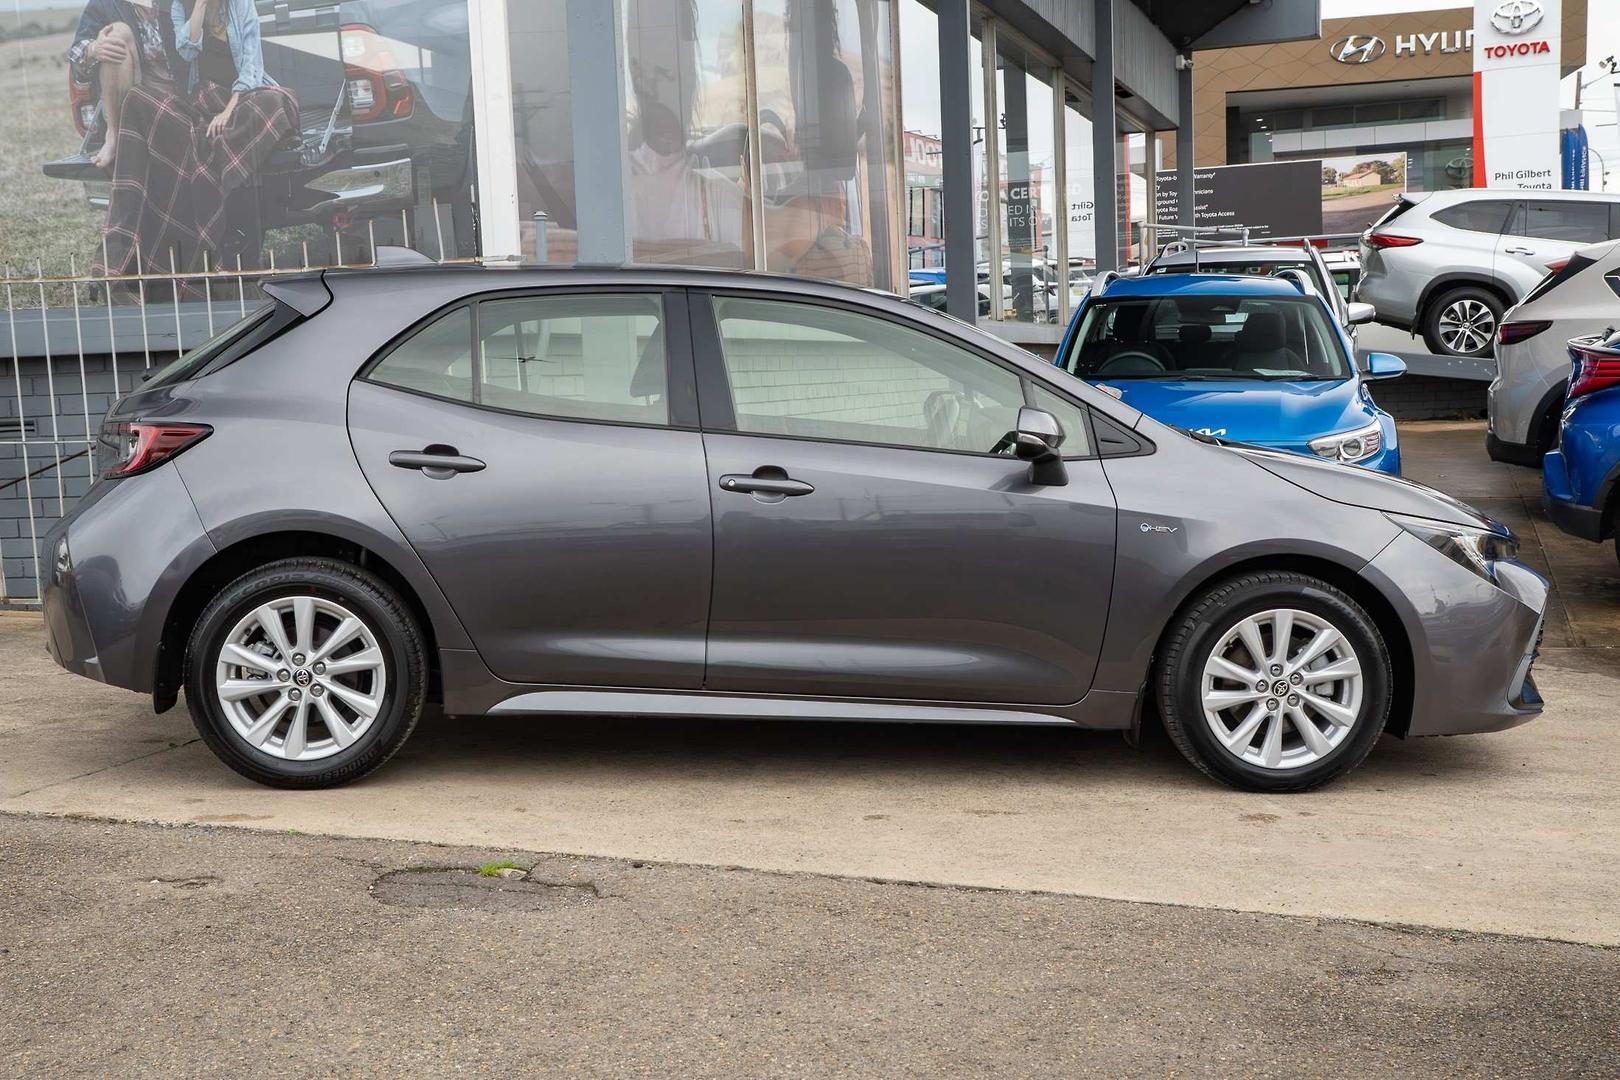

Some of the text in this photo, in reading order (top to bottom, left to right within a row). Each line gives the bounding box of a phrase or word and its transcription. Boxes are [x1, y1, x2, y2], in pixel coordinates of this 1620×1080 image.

[1484, 41, 1551, 59] TOYOTA
[1494, 169, 1552, 181] Phil Gilbert
[1169, 190, 1178, 198] Toy
